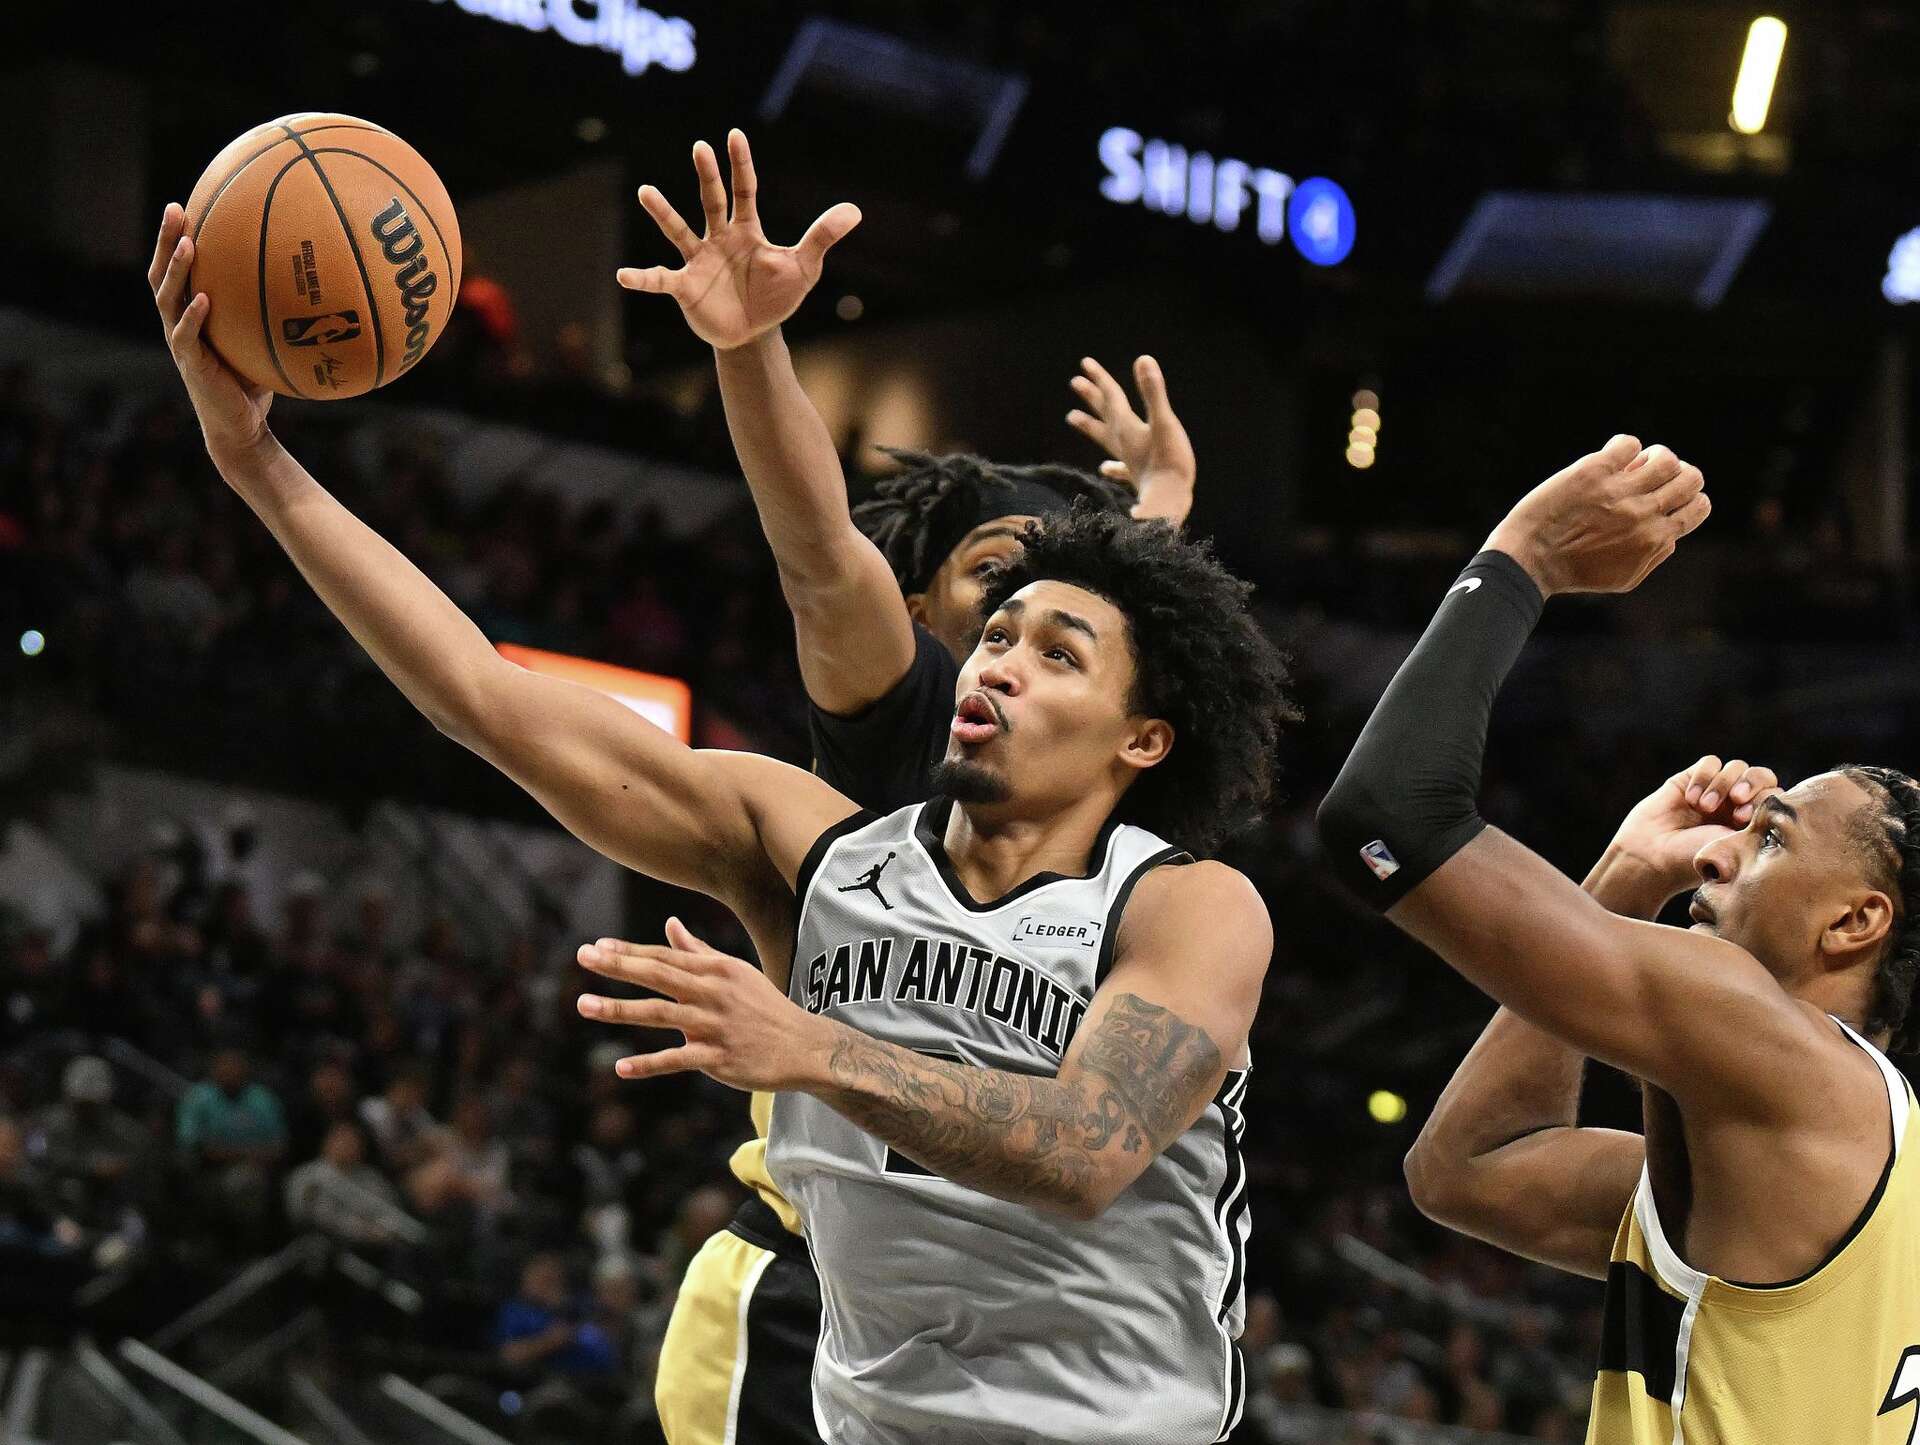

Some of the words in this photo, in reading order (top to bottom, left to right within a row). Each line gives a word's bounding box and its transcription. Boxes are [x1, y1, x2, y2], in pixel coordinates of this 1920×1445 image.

[371, 195, 438, 371] Wilson
[1024, 923, 1088, 939] LEDGER
[806, 937, 895, 1016] SAN
